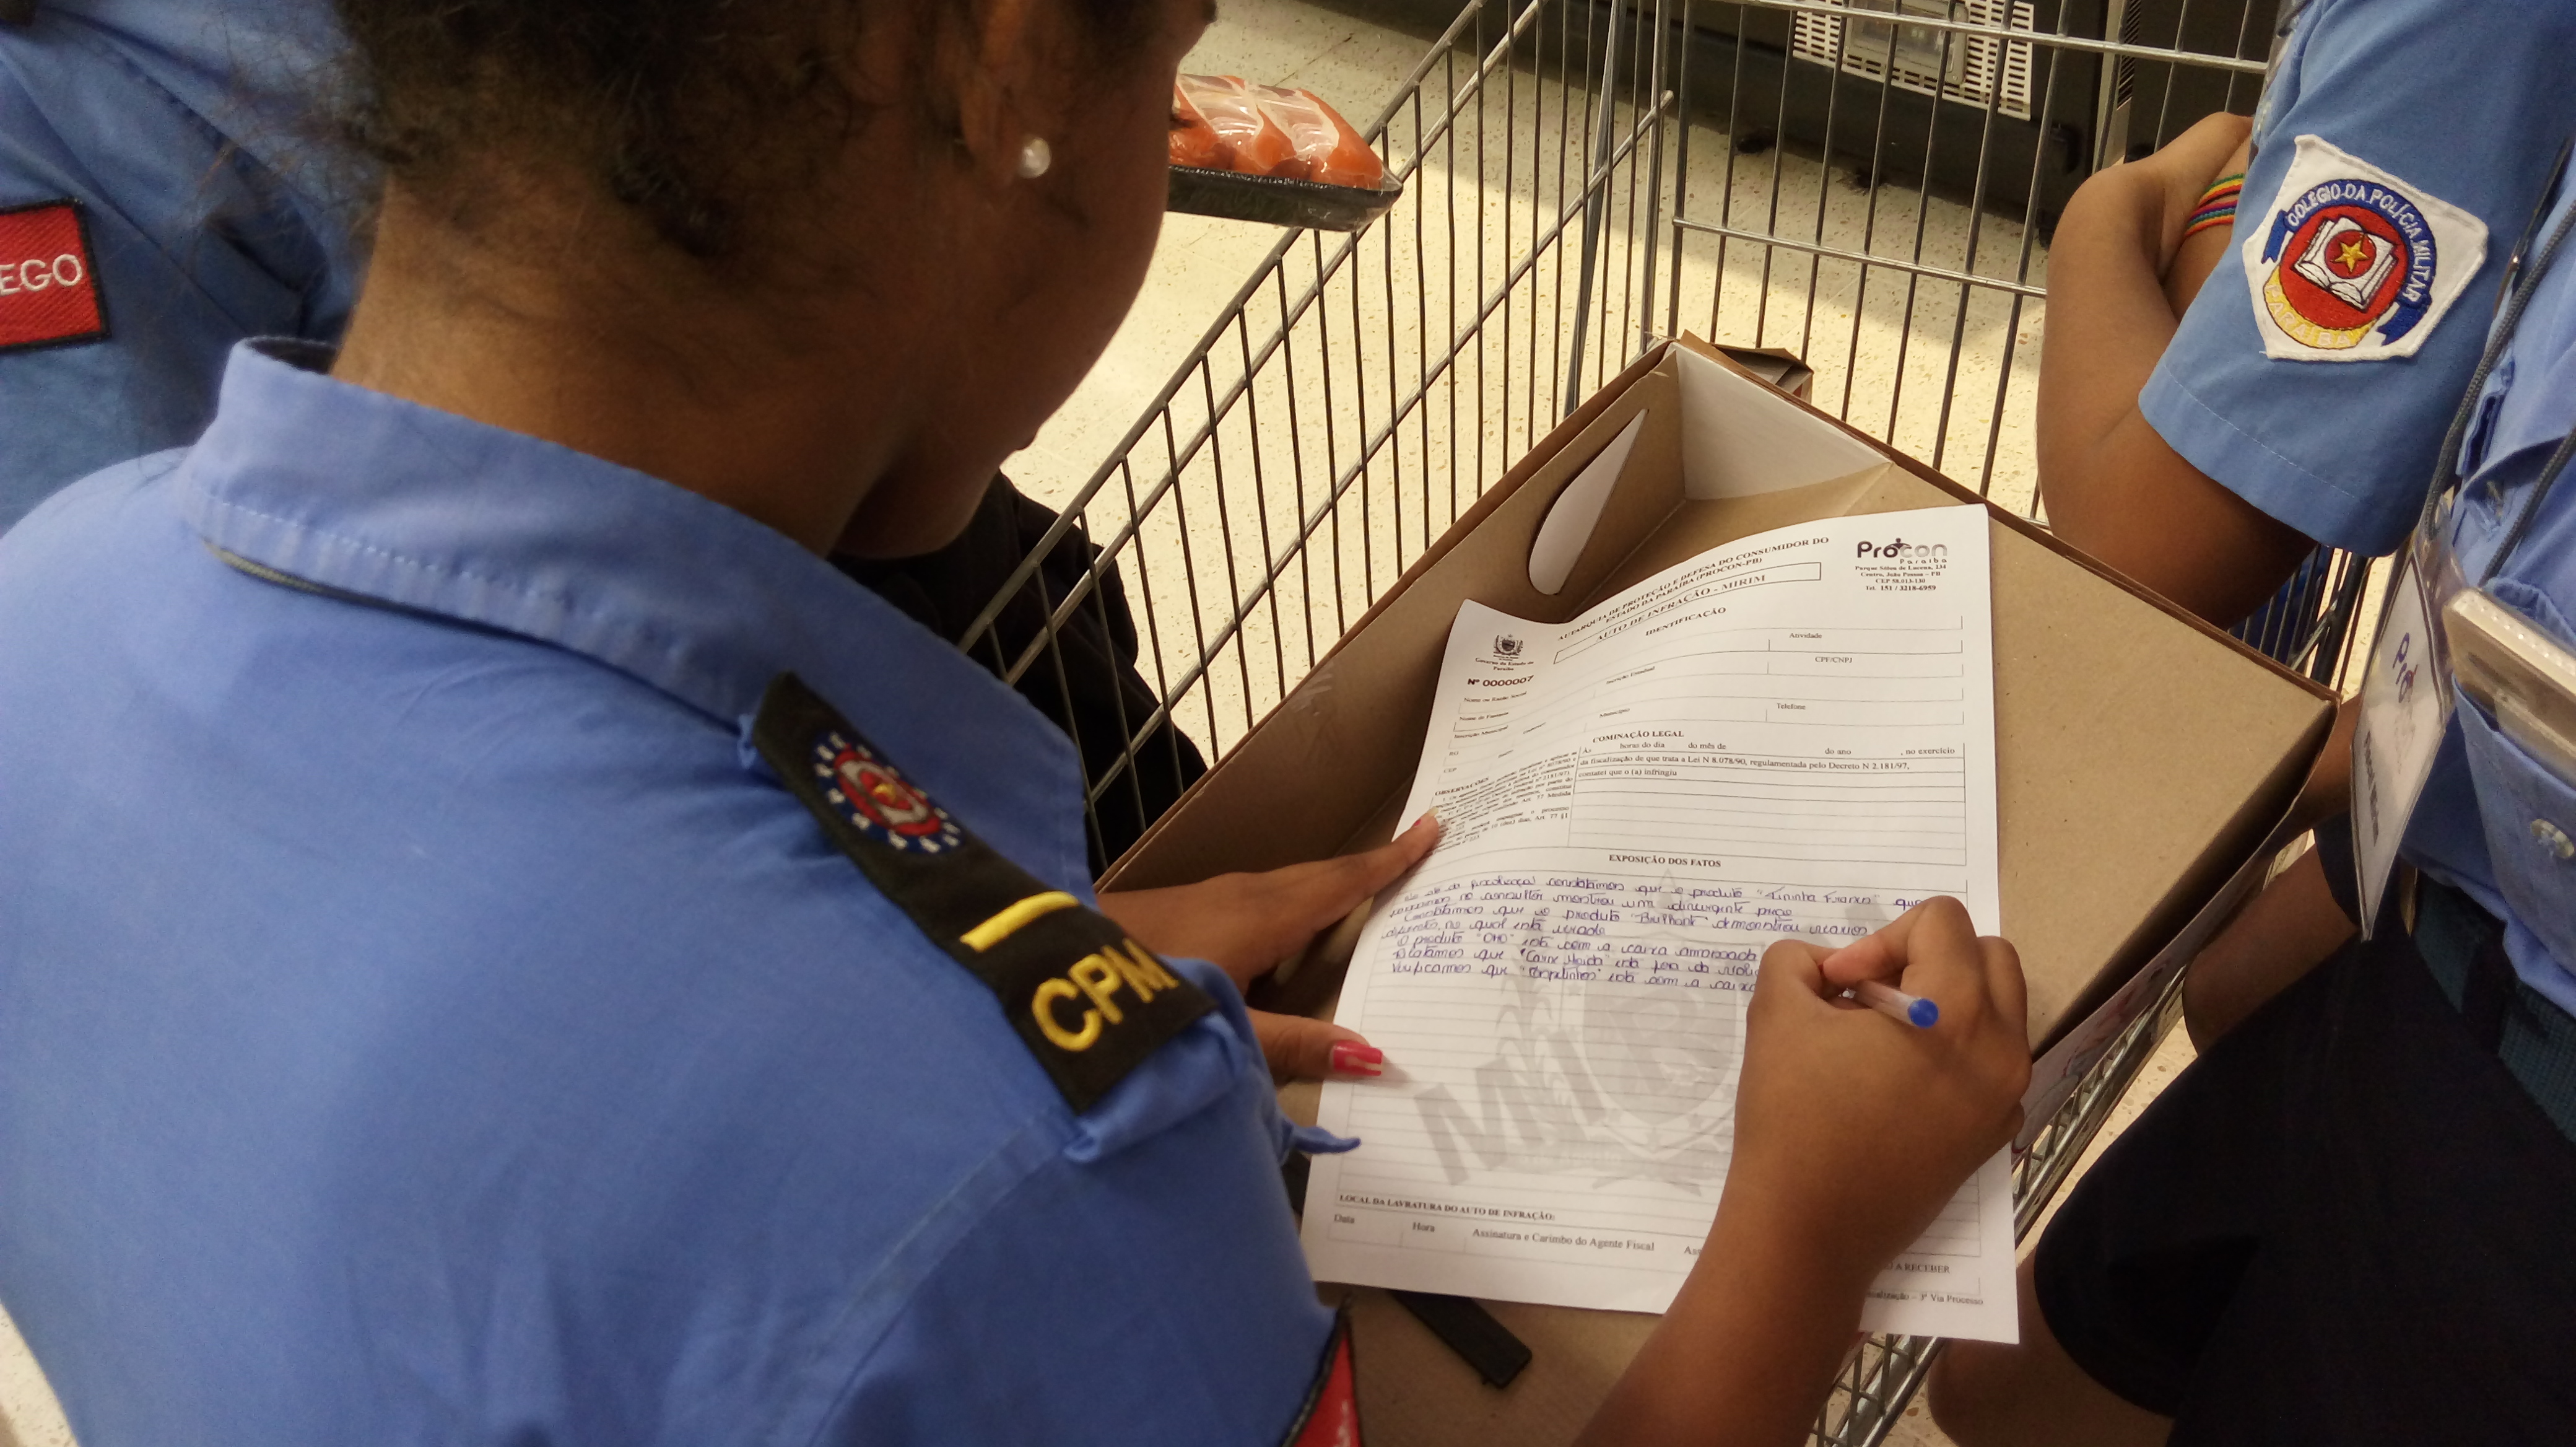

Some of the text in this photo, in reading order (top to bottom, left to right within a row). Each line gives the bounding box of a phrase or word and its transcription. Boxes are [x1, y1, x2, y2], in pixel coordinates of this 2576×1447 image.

[2345, 183, 2365, 201] DA
[2403, 239, 2431, 302] MILITAR
[1857, 538, 1948, 558] Procon
[1557, 614, 1607, 641] AUTARQUIA
[1609, 606, 1621, 616] DE
[1622, 583, 1671, 610] PROTEÇÃO
[1681, 562, 1717, 582] DEFESA
[1718, 557, 1734, 566] DO
[1736, 539, 1809, 561] CONSUMIDOR
[1812, 536, 1830, 546] DO
[1606, 557, 1762, 623] ESTADO DA PARAÍBA (PROCON-PB)
[1596, 623, 1628, 642] AUTO
[1630, 616, 1645, 626] DE
[1648, 588, 1710, 617] INFRAÇÃO
[1721, 575, 1766, 591] MIRIM
[1645, 606, 1726, 636] IDENTIFICAÇÃO
[1789, 632, 1822, 640] Atividade
[1482, 675, 1534, 687] 0000007
[1510, 691, 1528, 699] Social
[1777, 702, 1806, 710] Telefone
[1592, 730, 1685, 744] COMINAÇÃO LEGAL
[1824, 747, 1835, 755] do
[1918, 747, 1956, 756] exercício
[1591, 755, 1634, 764] fiscalização
[1712, 757, 1748, 766] 8.078/90,
[1750, 759, 1808, 769] regulamentada
[1809, 761, 1827, 770] pelo
[1829, 761, 1860, 770] Decreto
[1862, 762, 1870, 770] N
[1872, 762, 1910, 771] 2.181/97,
[1631, 768, 1643, 776] (a)
[1644, 768, 1677, 777] infringiu
[1608, 854, 1721, 868] EXPOSIÇÃO DOS FATOS
[1687, 887, 1743, 899] produto
[1621, 899, 1656, 909] um
[1562, 909, 1621, 922] produto
[1412, 930, 1465, 950] produto
[1032, 937, 1179, 1052] CPM
[1339, 1194, 1371, 1205] LOCAL
[1372, 1197, 1385, 1206] DA
[1386, 1199, 1443, 1212] LAVRATURA
[1444, 1204, 1459, 1213] DO
[1460, 1205, 1486, 1216] AUTO
[1487, 1208, 1500, 1217] DE
[1333, 1213, 1355, 1224] Data
[1412, 1221, 1435, 1233] Hora
[1472, 1228, 1521, 1241] Assinatura
[1532, 1231, 1573, 1246] Carimbo
[1575, 1236, 1588, 1246] do
[1589, 1237, 1624, 1249] Agente
[1625, 1239, 1655, 1251] Fiscal
[1904, 1262, 1951, 1275] RECEBER
[1930, 1294, 1984, 1305] Via Processo
